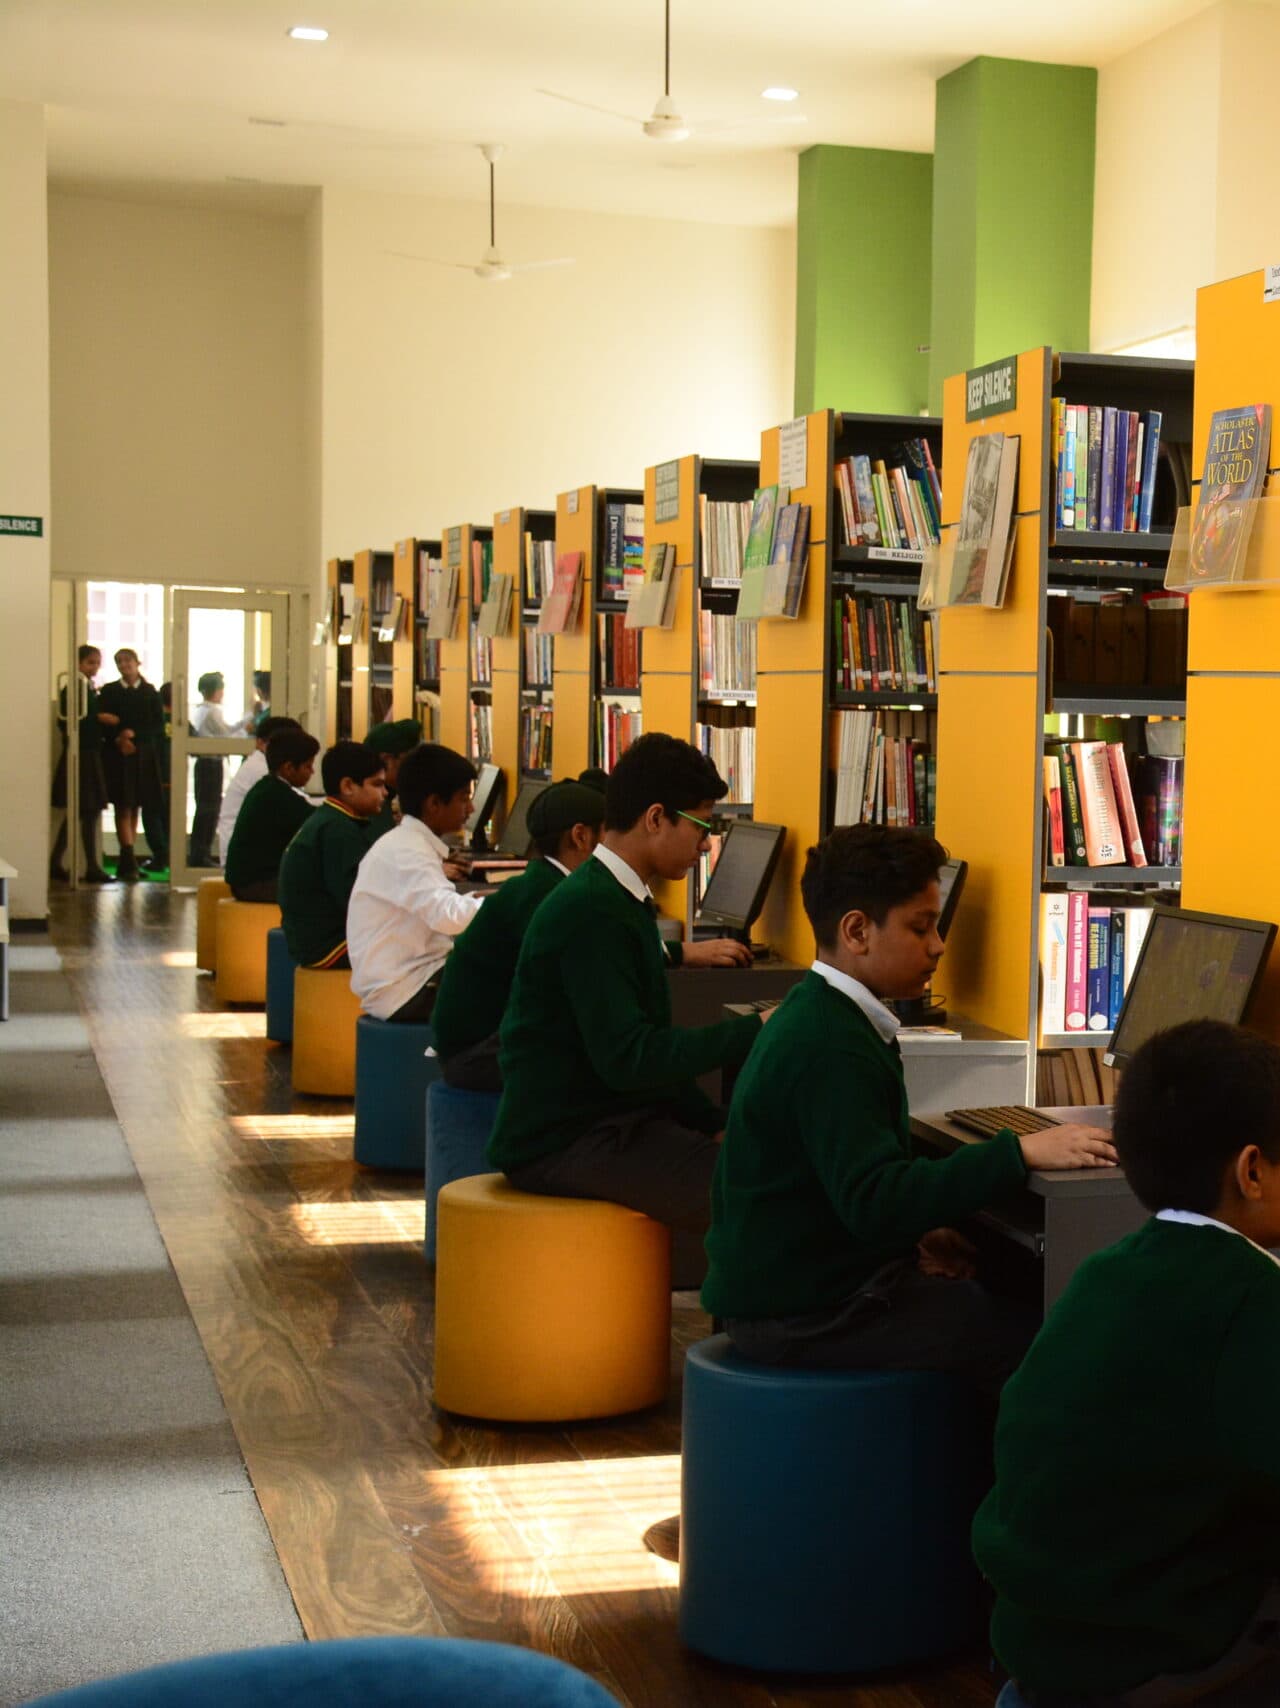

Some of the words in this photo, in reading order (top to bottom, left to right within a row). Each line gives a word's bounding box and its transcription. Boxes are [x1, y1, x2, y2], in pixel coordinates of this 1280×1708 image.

[967, 375, 984, 413] KEEP
[984, 365, 1012, 406] SILENCE
[1211, 428, 1255, 454] ATLAS
[1231, 452, 1243, 462] THE
[1207, 458, 1253, 486] WORLD
[0, 517, 38, 533] SILENCE
[609, 514, 618, 567] DICTIONARY
[1065, 765, 1079, 824] MATHEMATICS
[1089, 922, 1100, 970] REASONING
